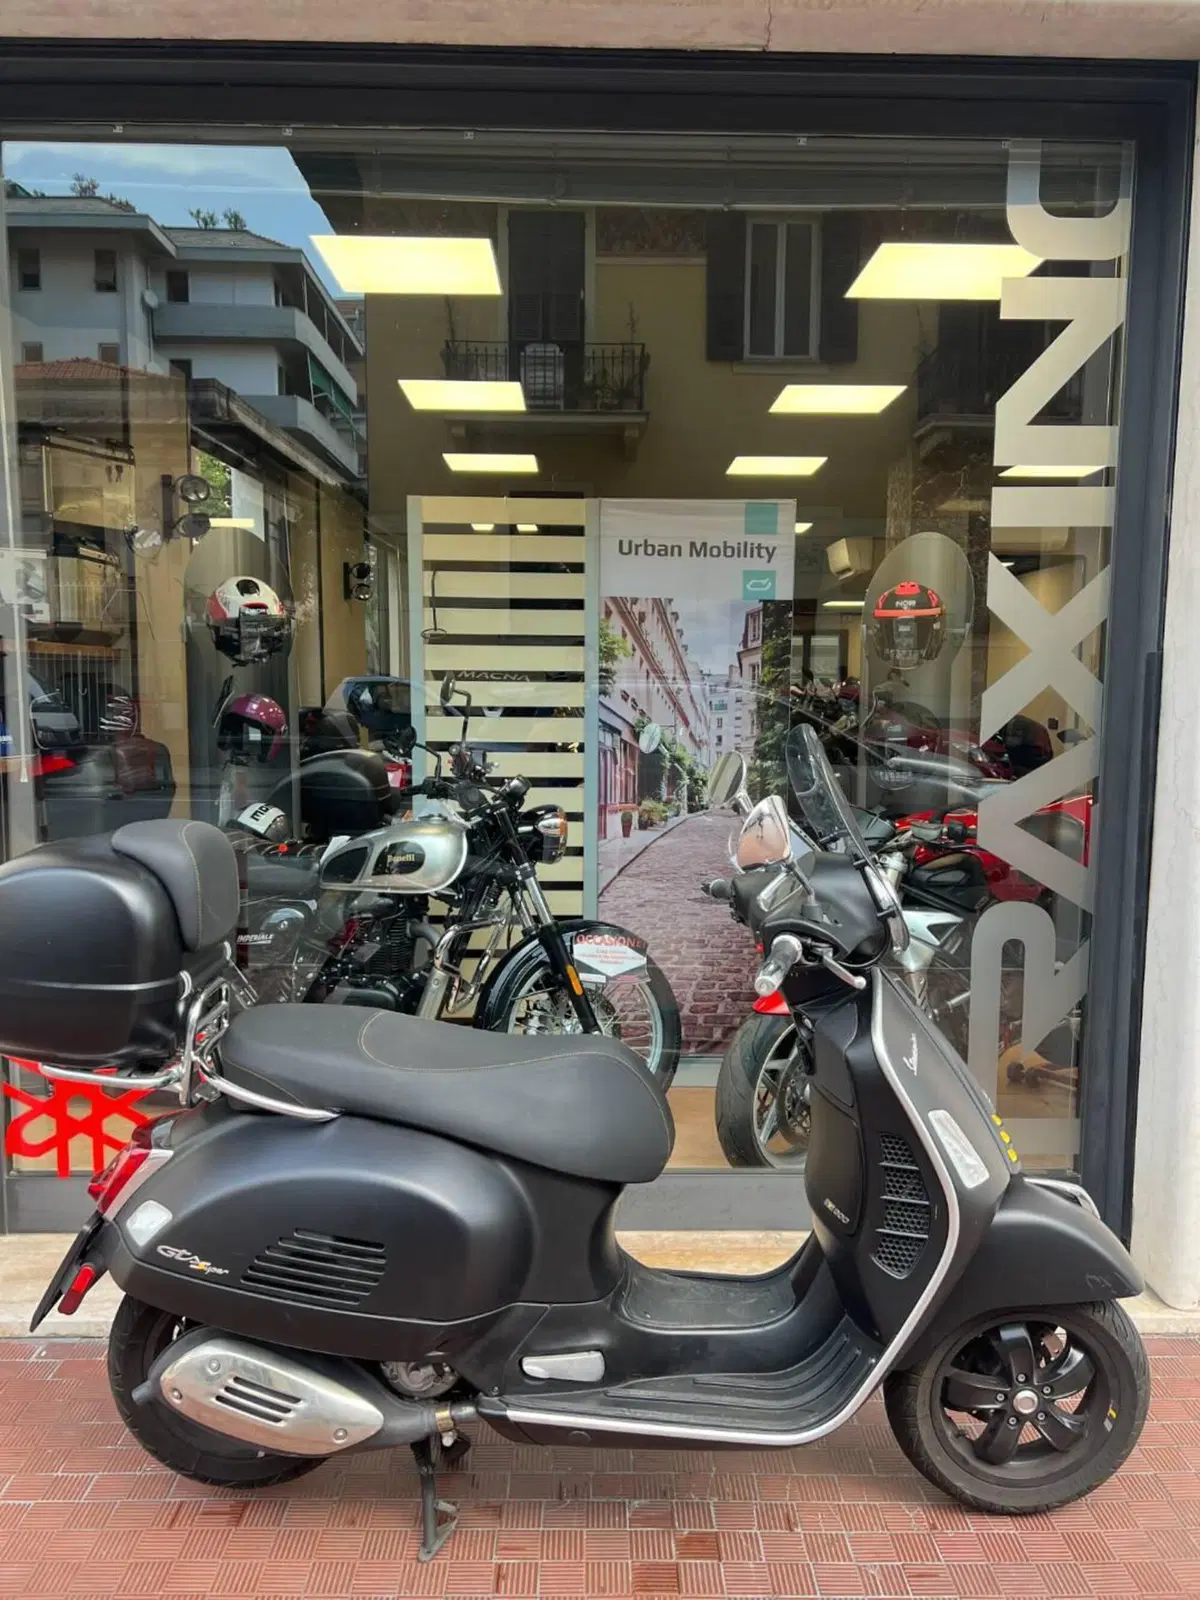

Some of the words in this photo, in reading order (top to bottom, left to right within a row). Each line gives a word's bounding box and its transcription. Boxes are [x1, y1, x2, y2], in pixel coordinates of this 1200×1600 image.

[618, 538, 683, 558] Urban
[688, 540, 777, 564] Mobility
[457, 670, 530, 682] MACNA
